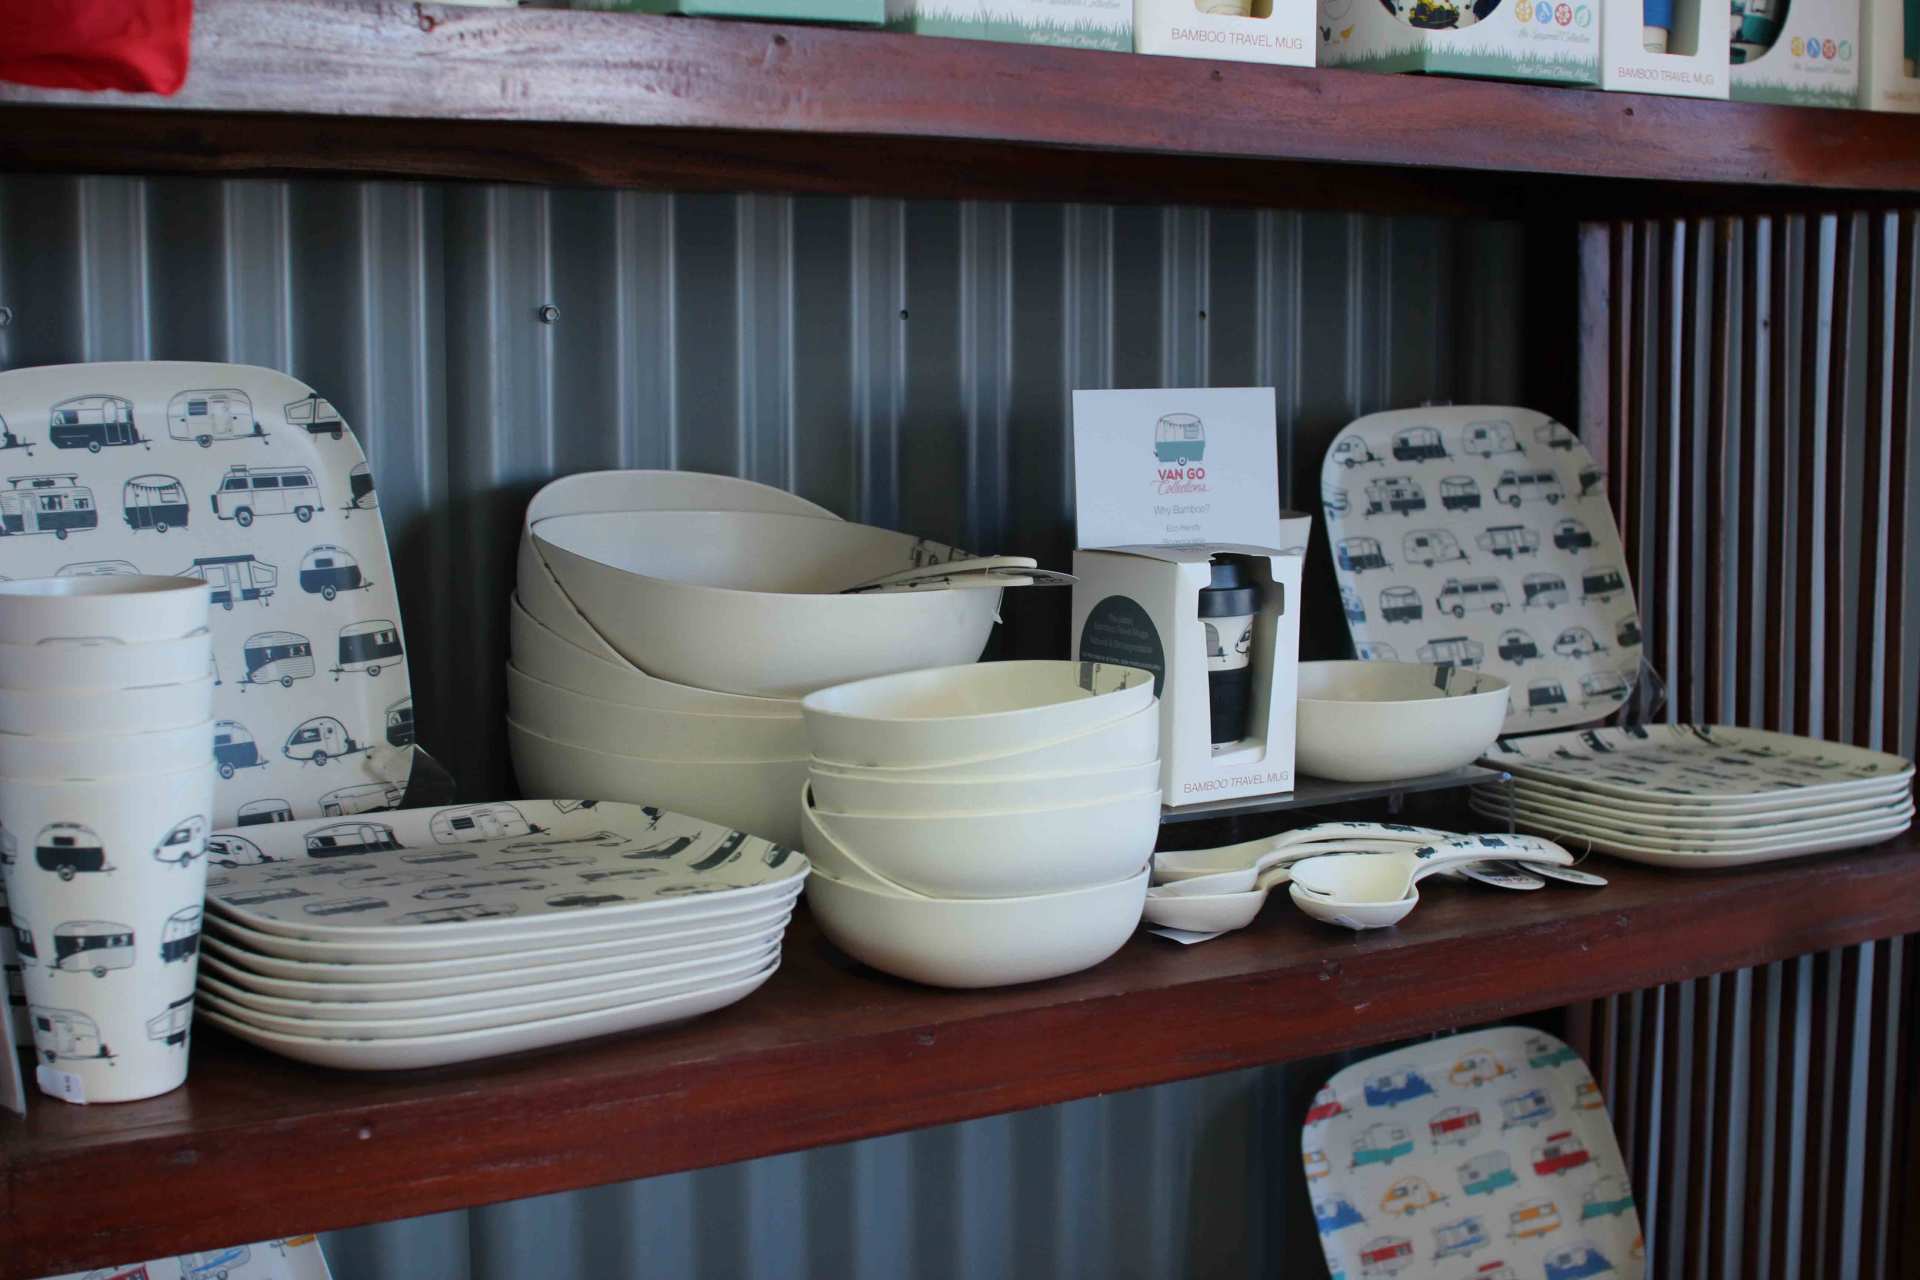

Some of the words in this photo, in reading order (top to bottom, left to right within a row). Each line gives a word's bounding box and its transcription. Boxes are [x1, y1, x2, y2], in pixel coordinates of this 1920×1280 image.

[1171, 27, 1226, 43] BAMBOO
[1229, 32, 1272, 48] TRAVEL
[1275, 37, 1303, 50] MUG
[1617, 66, 1659, 80] BAMBOO
[1660, 70, 1691, 83] TRAVEL
[1694, 72, 1714, 86] MUG
[1158, 468, 1184, 480] VAN
[1186, 467, 1205, 480] GO
[1153, 504, 1171, 516] Why
[1183, 778, 1229, 794] BAMBOO
[1231, 774, 1265, 788] TRAVEL
[1266, 770, 1289, 785] MUG
